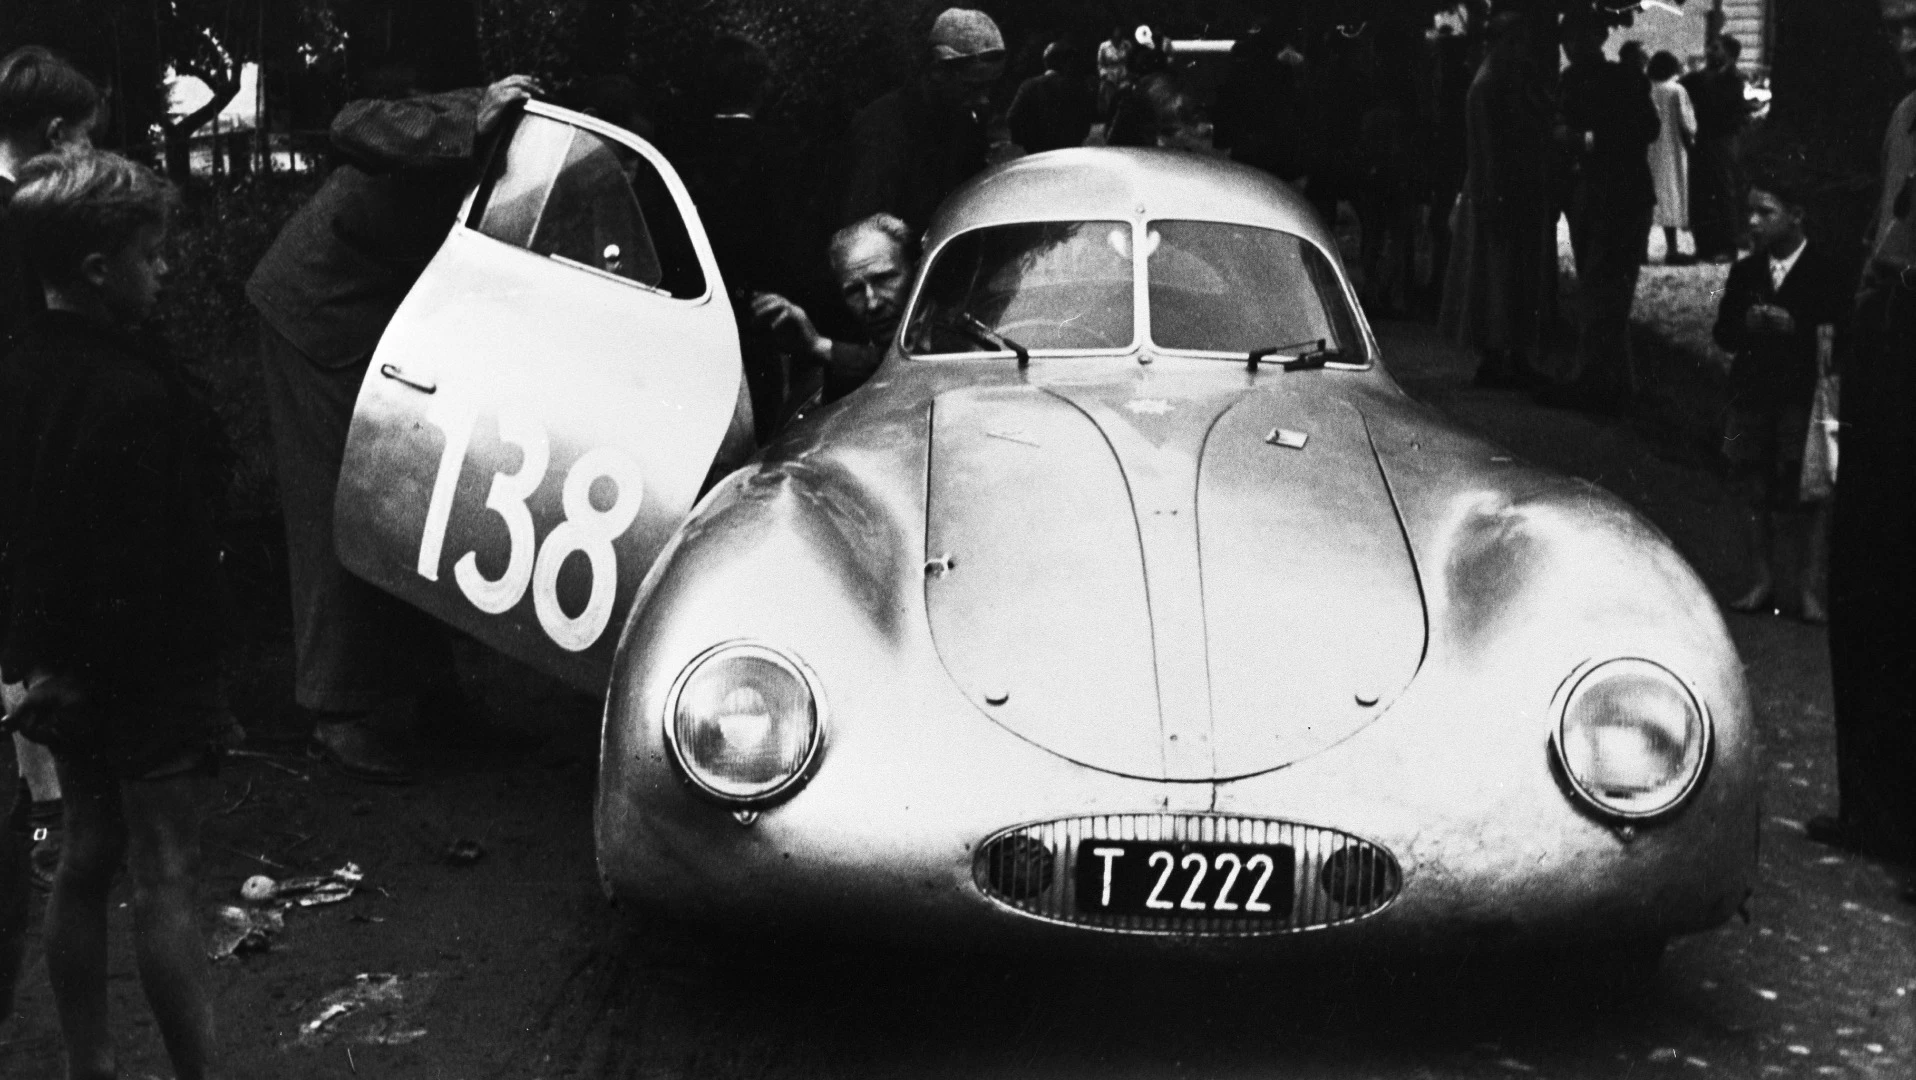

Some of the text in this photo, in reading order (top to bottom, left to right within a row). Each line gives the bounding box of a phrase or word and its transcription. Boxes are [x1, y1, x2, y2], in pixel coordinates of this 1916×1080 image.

[417, 394, 644, 651] 138
[1093, 847, 1274, 911] T 2222
